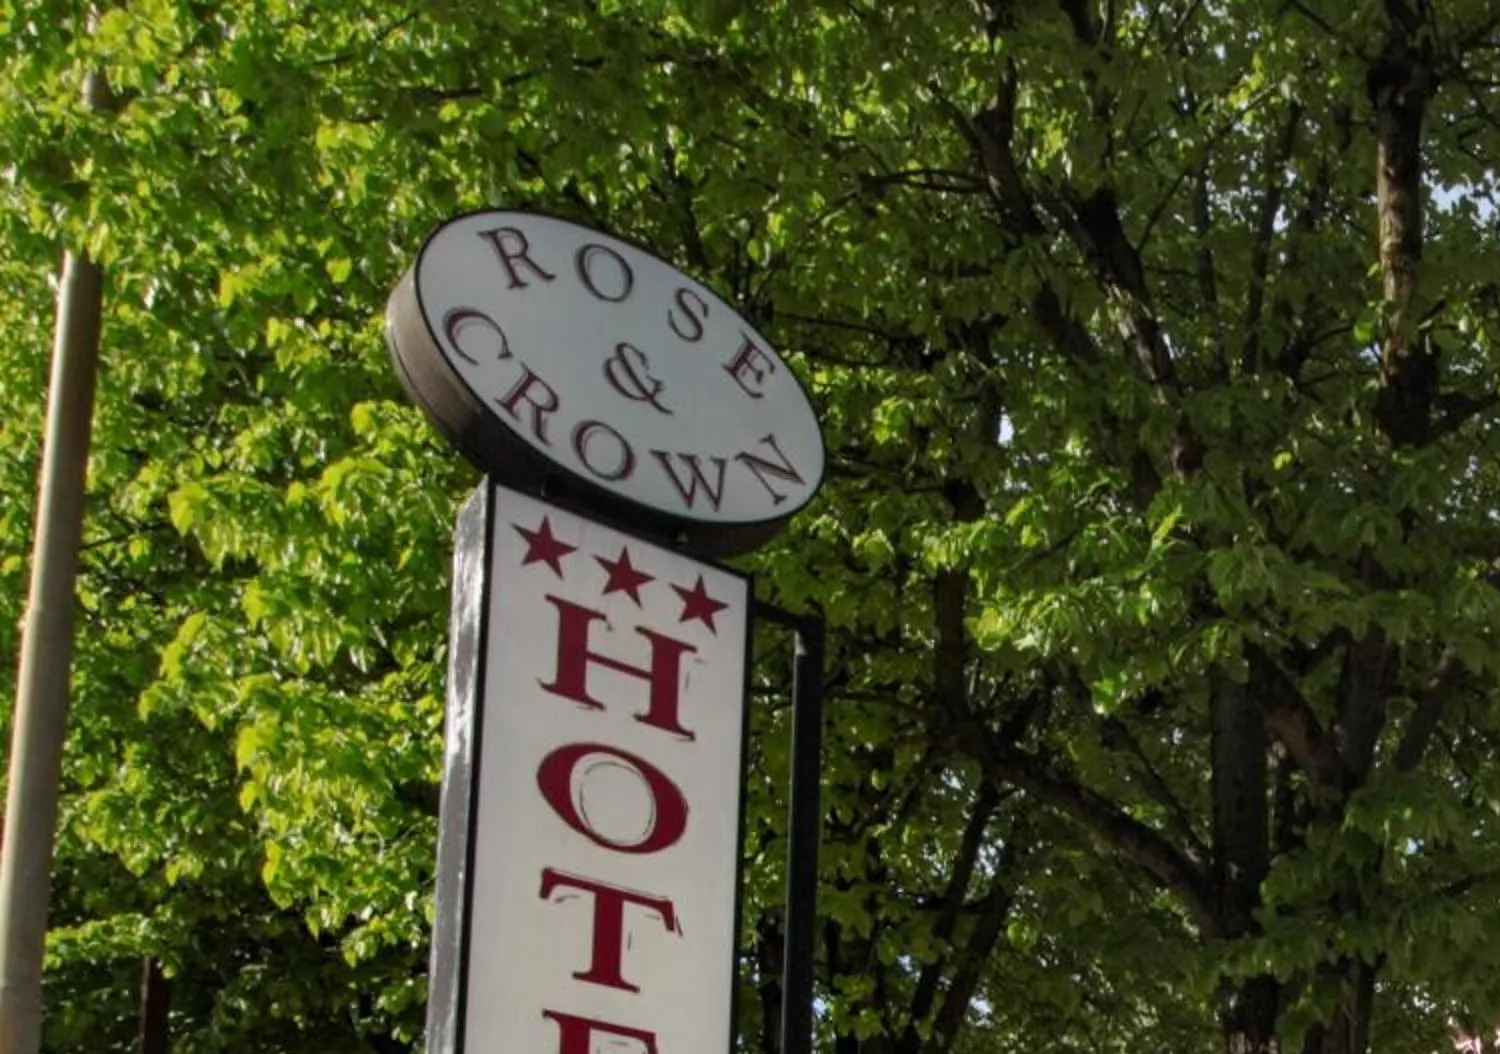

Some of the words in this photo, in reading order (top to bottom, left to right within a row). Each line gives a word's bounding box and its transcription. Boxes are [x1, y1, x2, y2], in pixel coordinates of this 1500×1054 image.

[478, 226, 776, 399] ROSE
[603, 341, 674, 417] &
[442, 305, 806, 513] CROWN
